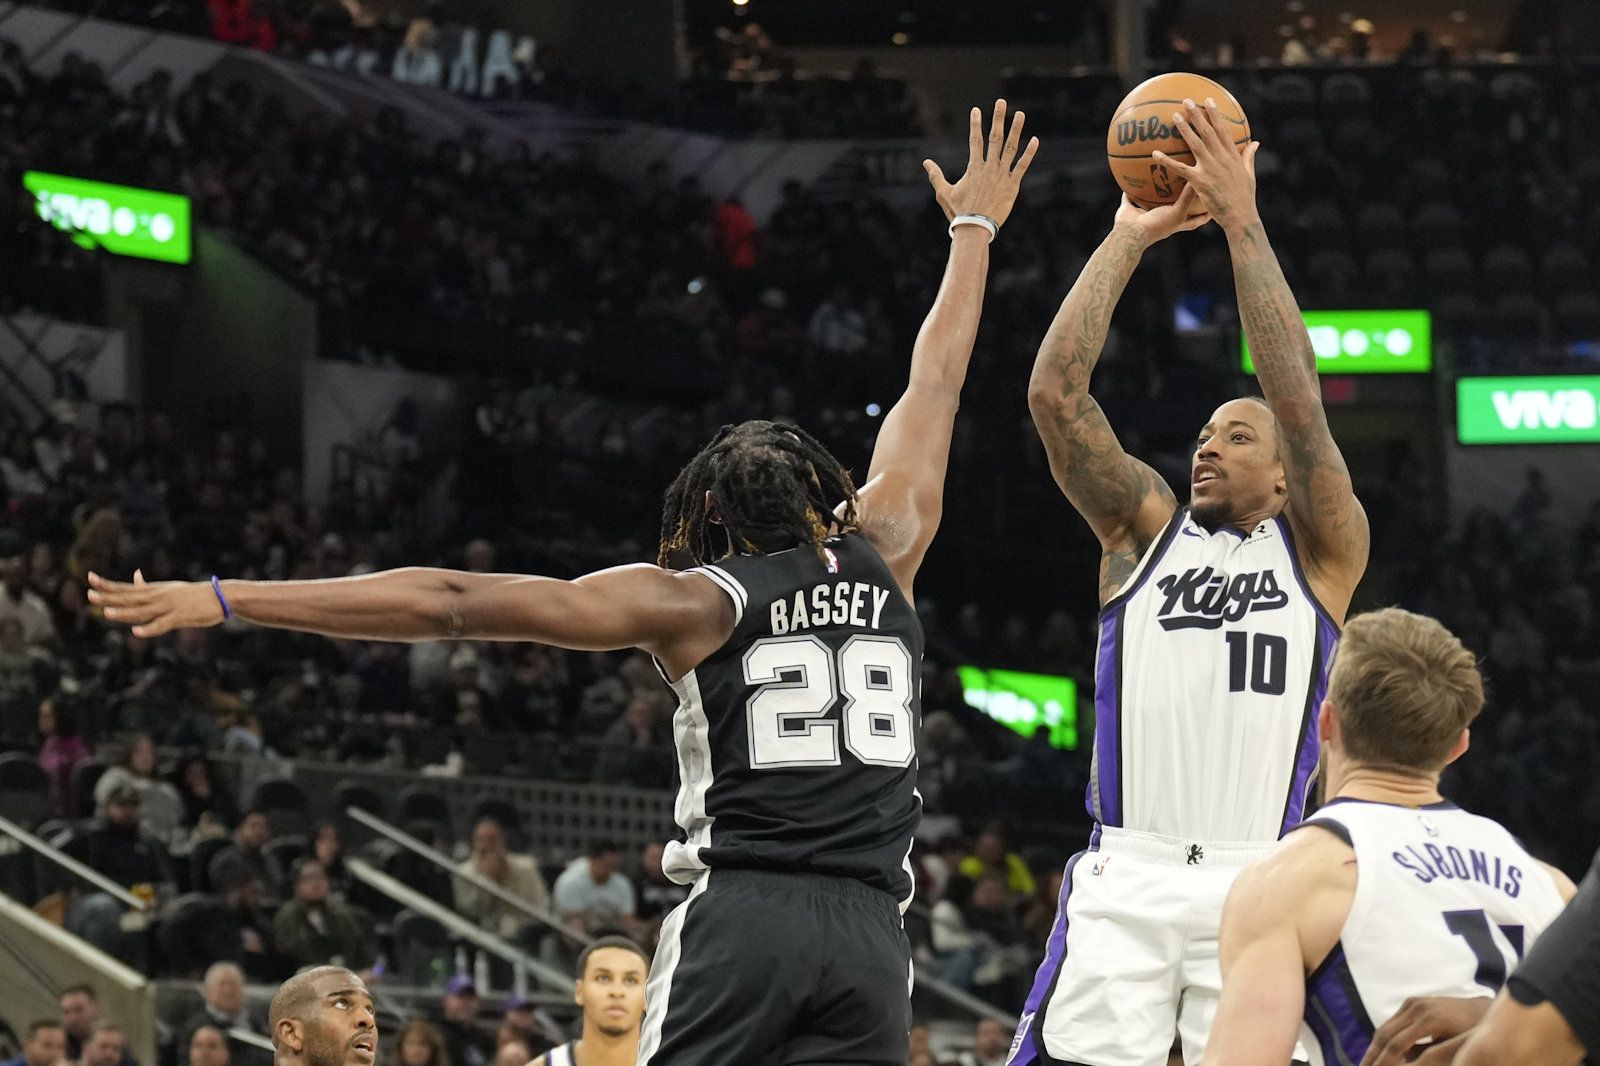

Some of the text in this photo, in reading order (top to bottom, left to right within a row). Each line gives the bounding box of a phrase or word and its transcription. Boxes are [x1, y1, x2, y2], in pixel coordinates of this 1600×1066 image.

[770, 581, 890, 635] BASSEY
[1225, 631, 1288, 696] 10
[742, 633, 916, 770] 28
